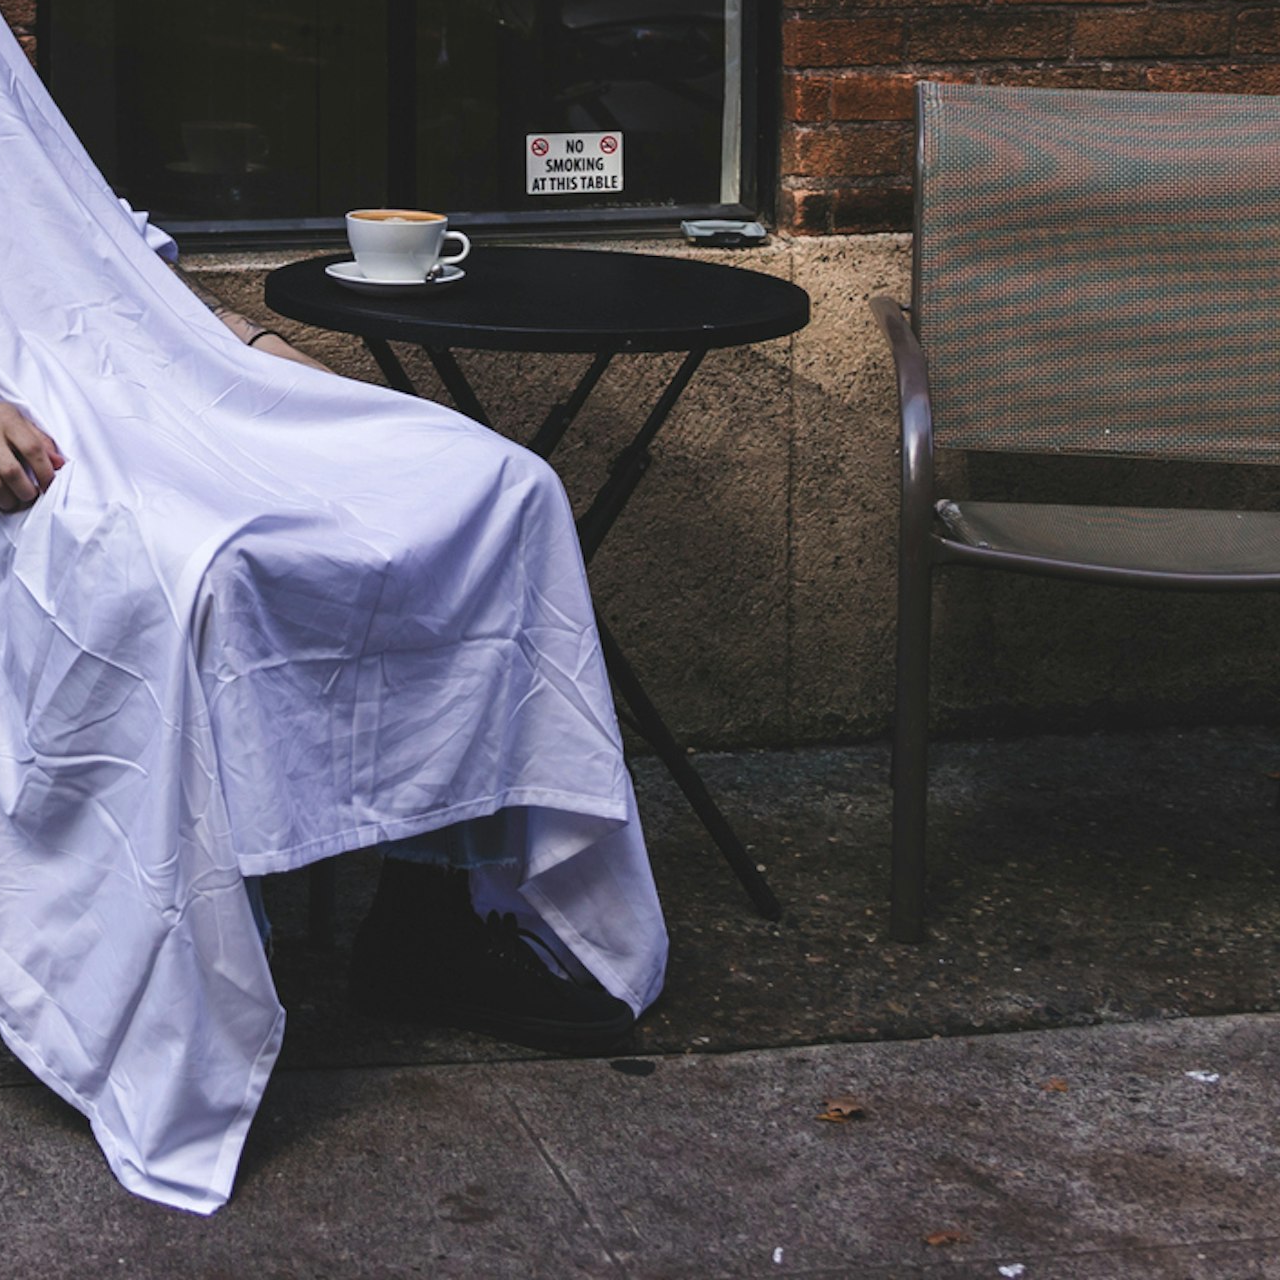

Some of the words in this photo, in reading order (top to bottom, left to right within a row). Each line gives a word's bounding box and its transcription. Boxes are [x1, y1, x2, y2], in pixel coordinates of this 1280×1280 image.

[566, 139, 584, 154] NO
[545, 157, 604, 172] SMOKING
[532, 177, 547, 191] AT
[549, 176, 577, 191] THIS
[580, 175, 618, 190] TABLE
